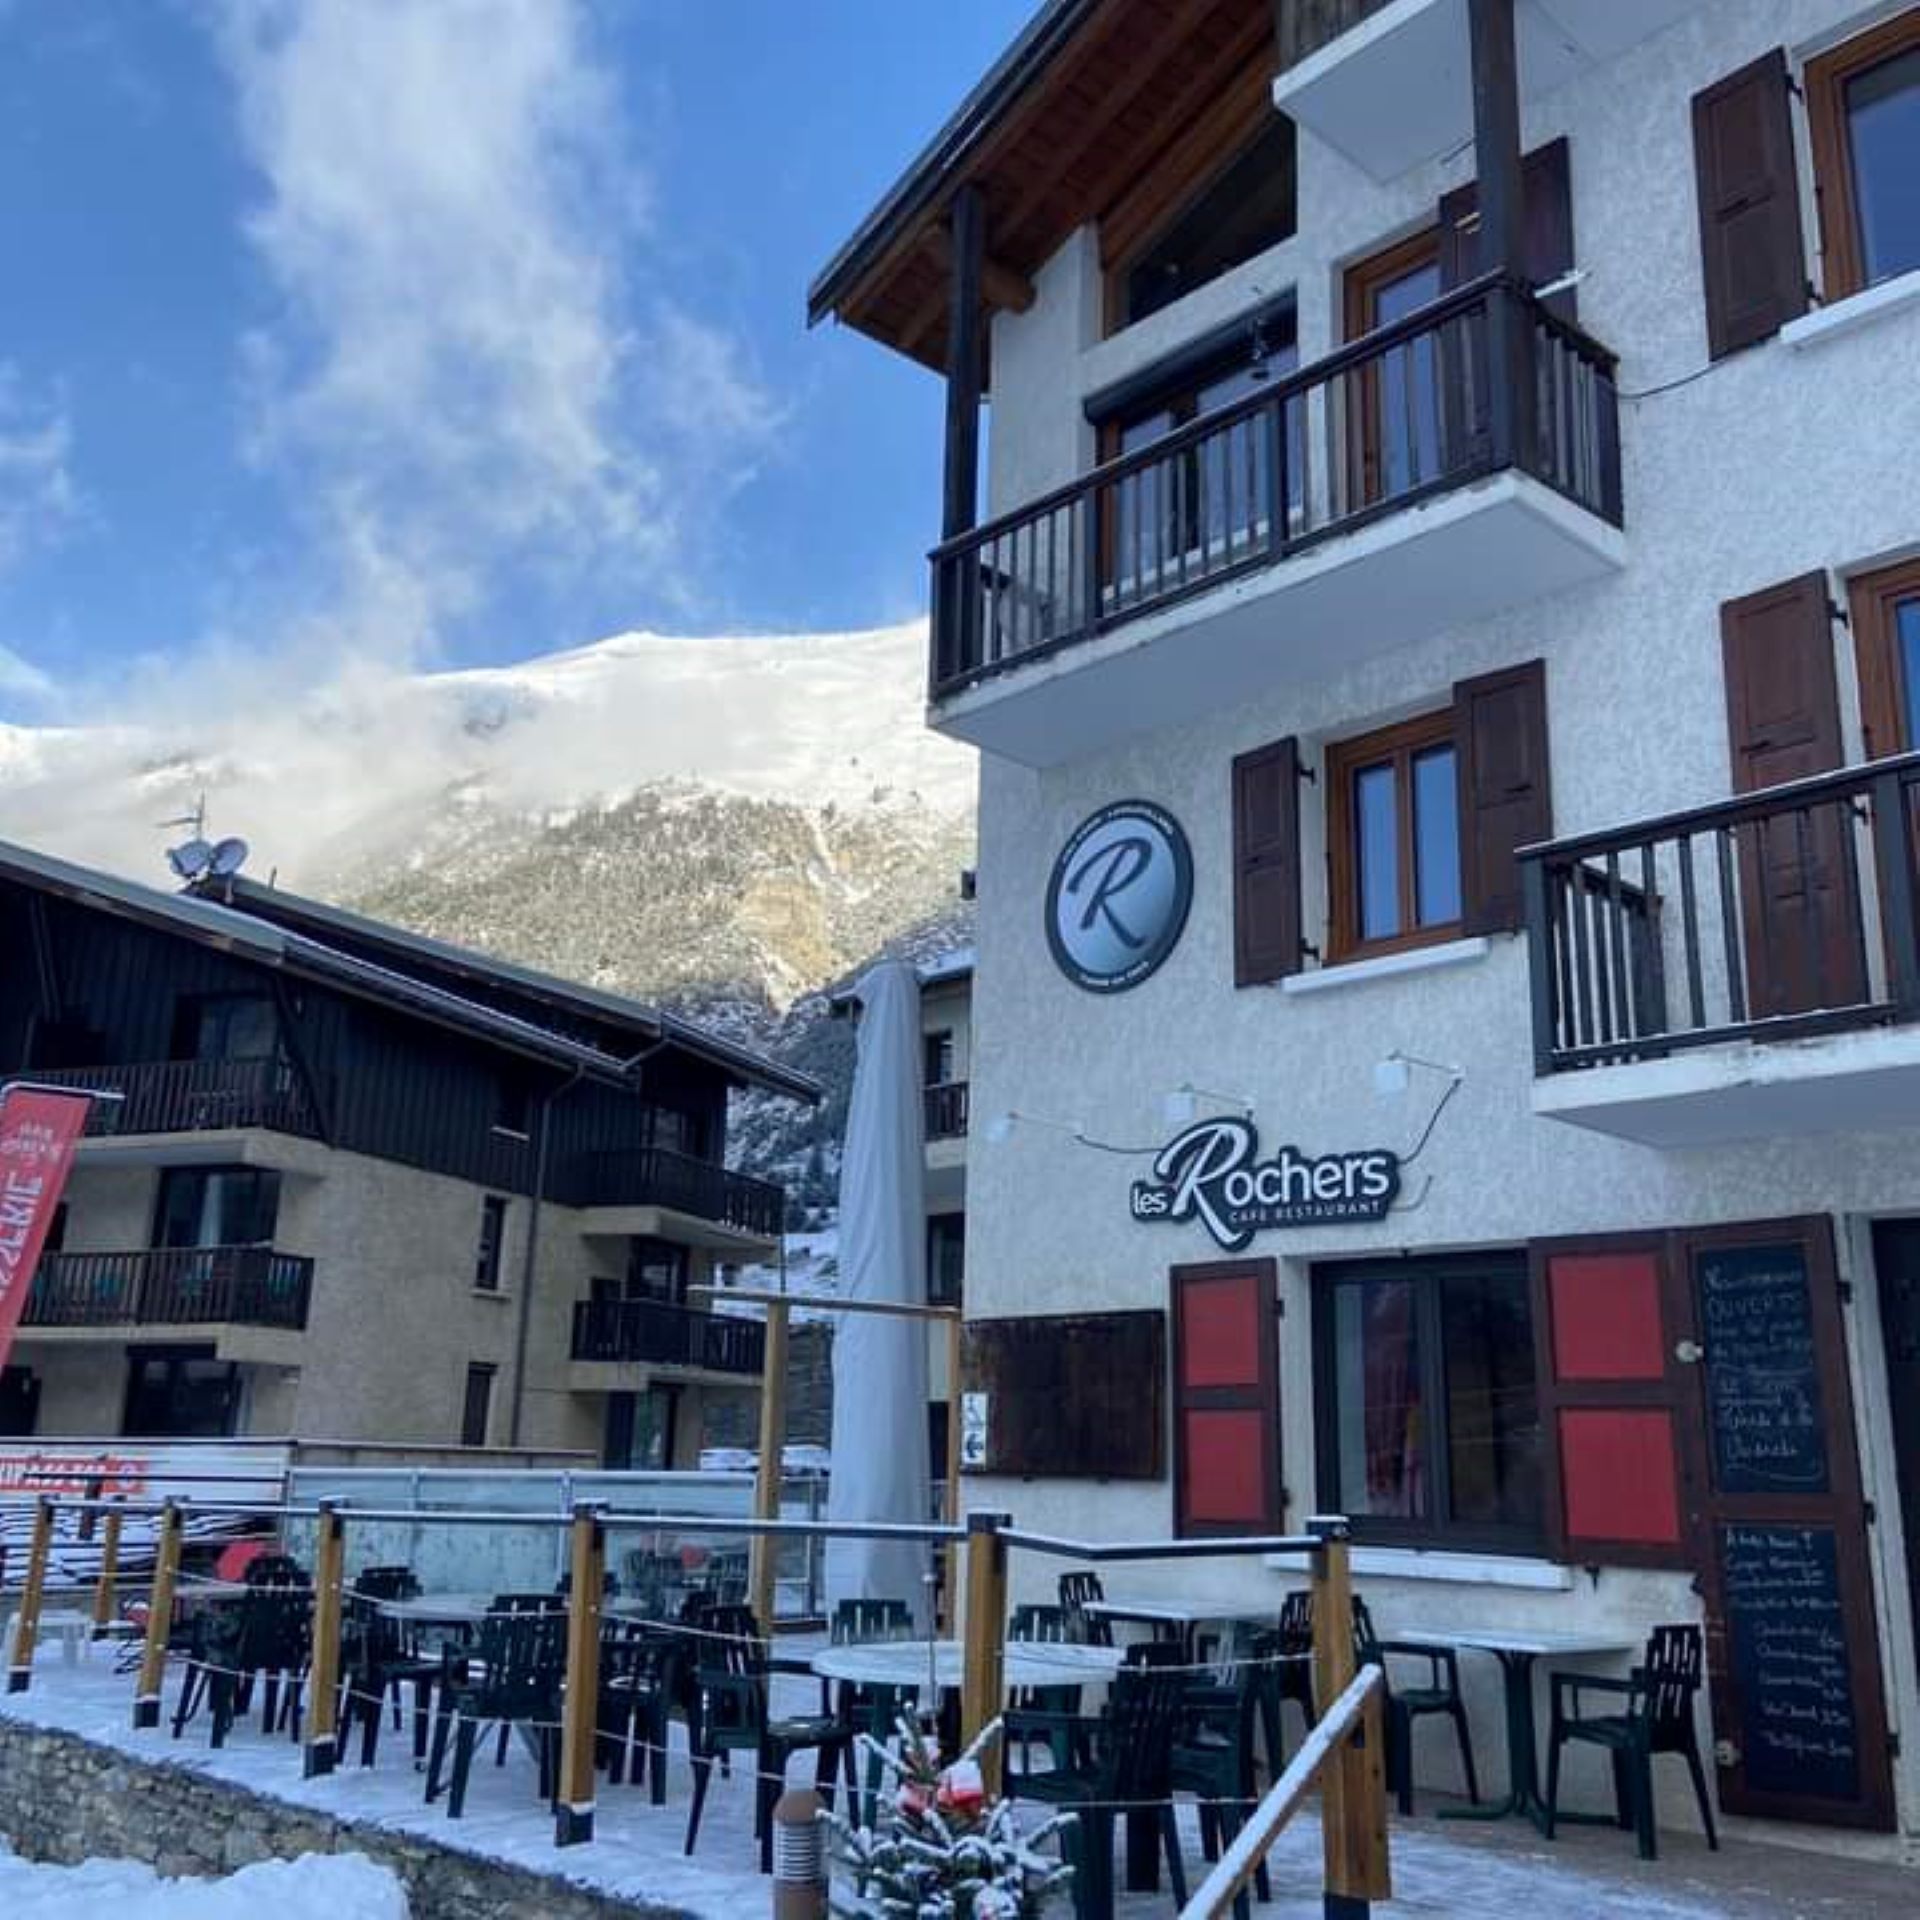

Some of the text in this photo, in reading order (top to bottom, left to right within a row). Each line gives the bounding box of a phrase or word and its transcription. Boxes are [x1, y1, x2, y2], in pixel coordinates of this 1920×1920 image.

[1066, 836, 1153, 949] R
[1134, 1122, 1390, 1244] les Rochers
[1275, 1200, 1379, 1219] RESTAURANT
